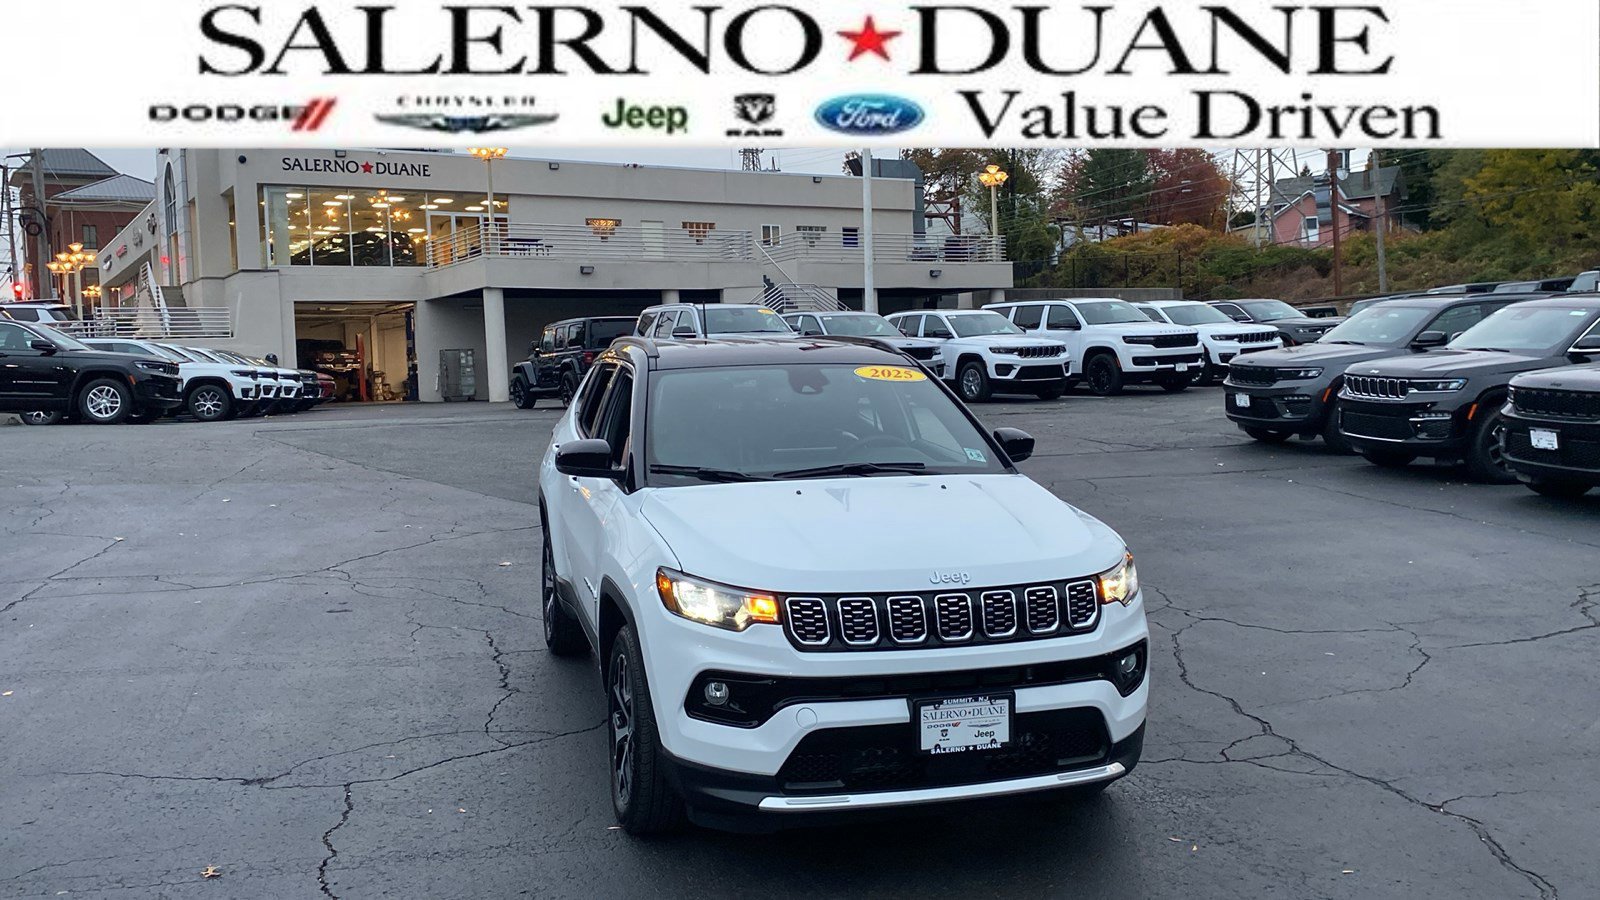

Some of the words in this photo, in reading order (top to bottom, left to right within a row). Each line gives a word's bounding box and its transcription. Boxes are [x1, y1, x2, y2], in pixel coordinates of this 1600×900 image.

[282, 157, 360, 174] SALERNO
[375, 161, 431, 177] DUANE
[870, 368, 913, 379] 2025
[929, 570, 971, 585] Jeep
[923, 708, 967, 720] SALERNO
[972, 706, 1006, 717] DUANE
[974, 730, 995, 738] Jeep
[930, 746, 966, 754] SALERNO
